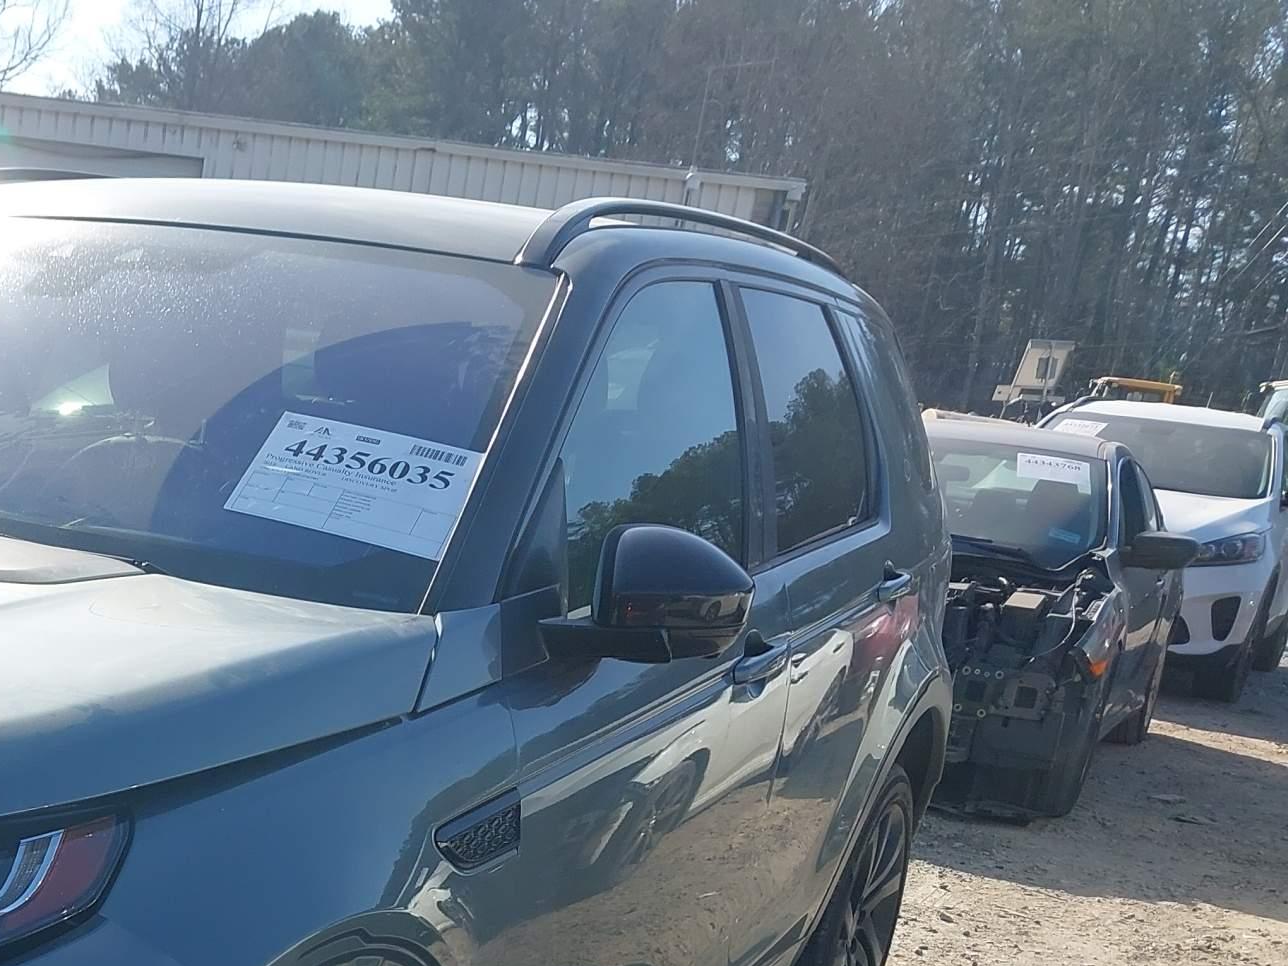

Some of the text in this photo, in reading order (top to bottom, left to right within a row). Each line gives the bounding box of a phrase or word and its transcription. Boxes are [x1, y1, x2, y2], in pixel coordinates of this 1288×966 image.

[266, 453, 314, 469] Progressive
[315, 464, 353, 477] Casualty
[355, 471, 398, 487] Insurance
[284, 439, 455, 490] 44356035
